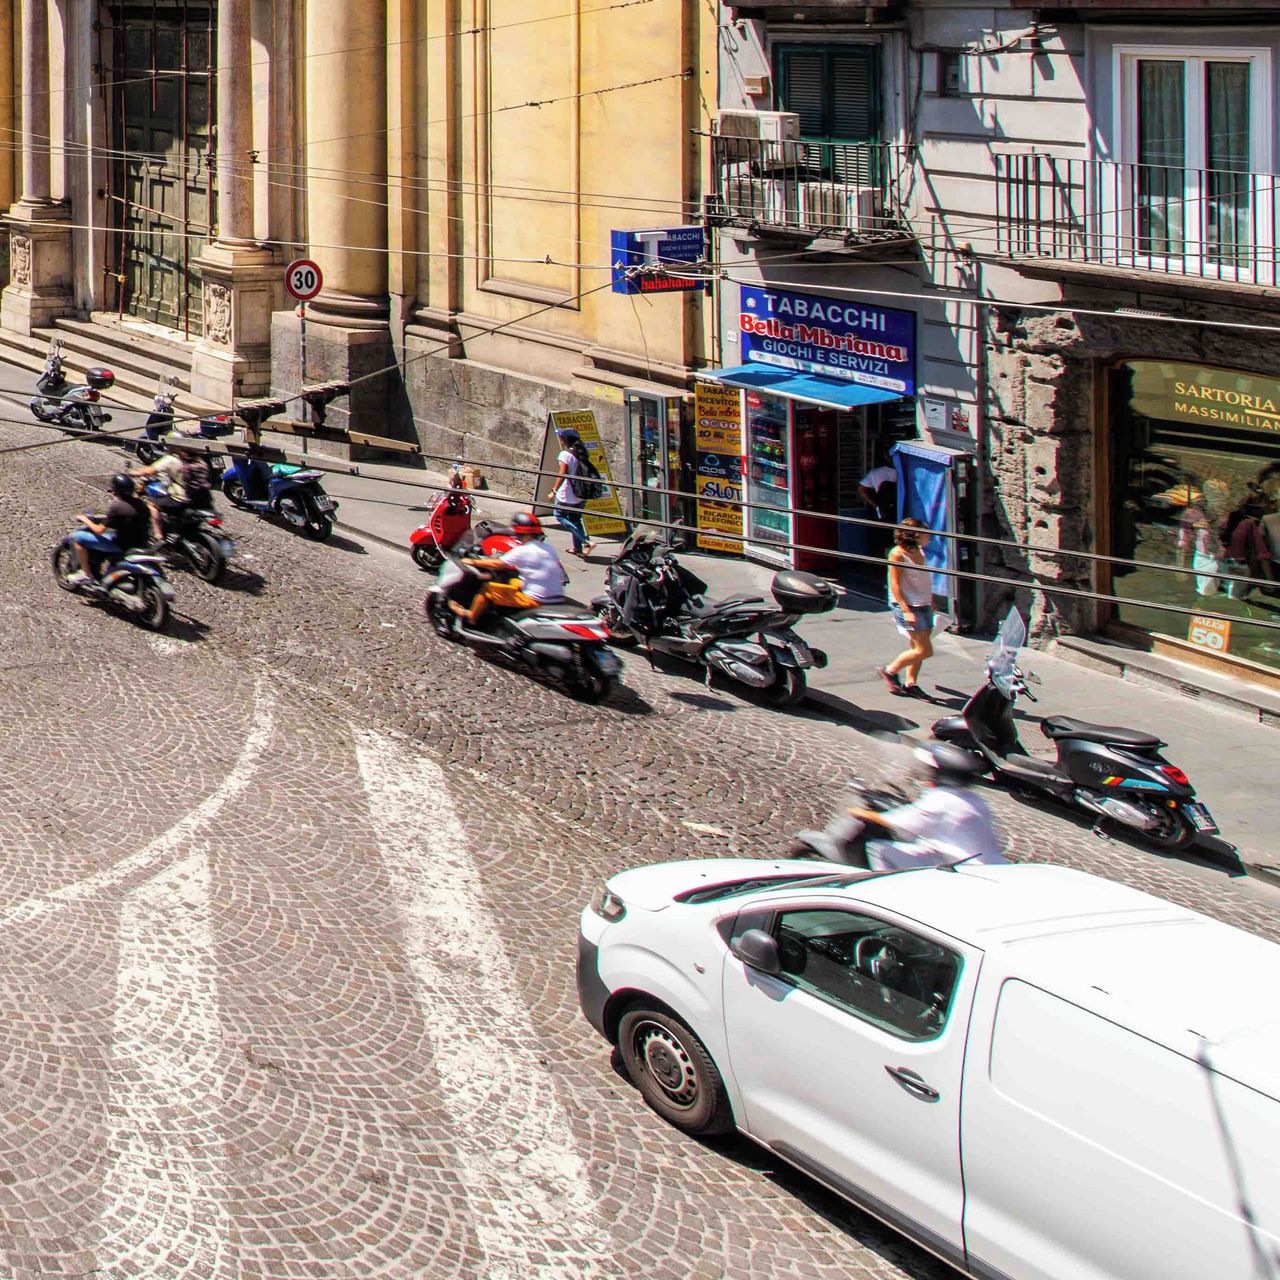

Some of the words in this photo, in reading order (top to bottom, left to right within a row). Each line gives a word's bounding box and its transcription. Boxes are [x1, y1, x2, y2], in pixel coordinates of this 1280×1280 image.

[294, 270, 315, 290] 30
[763, 293, 886, 332] TABACCHI
[763, 339, 812, 359] GIOCHI
[816, 349, 825, 363] E
[829, 352, 888, 375] SERVIZI
[1174, 381, 1277, 413] SARTORIA
[1192, 626, 1224, 649] 50
